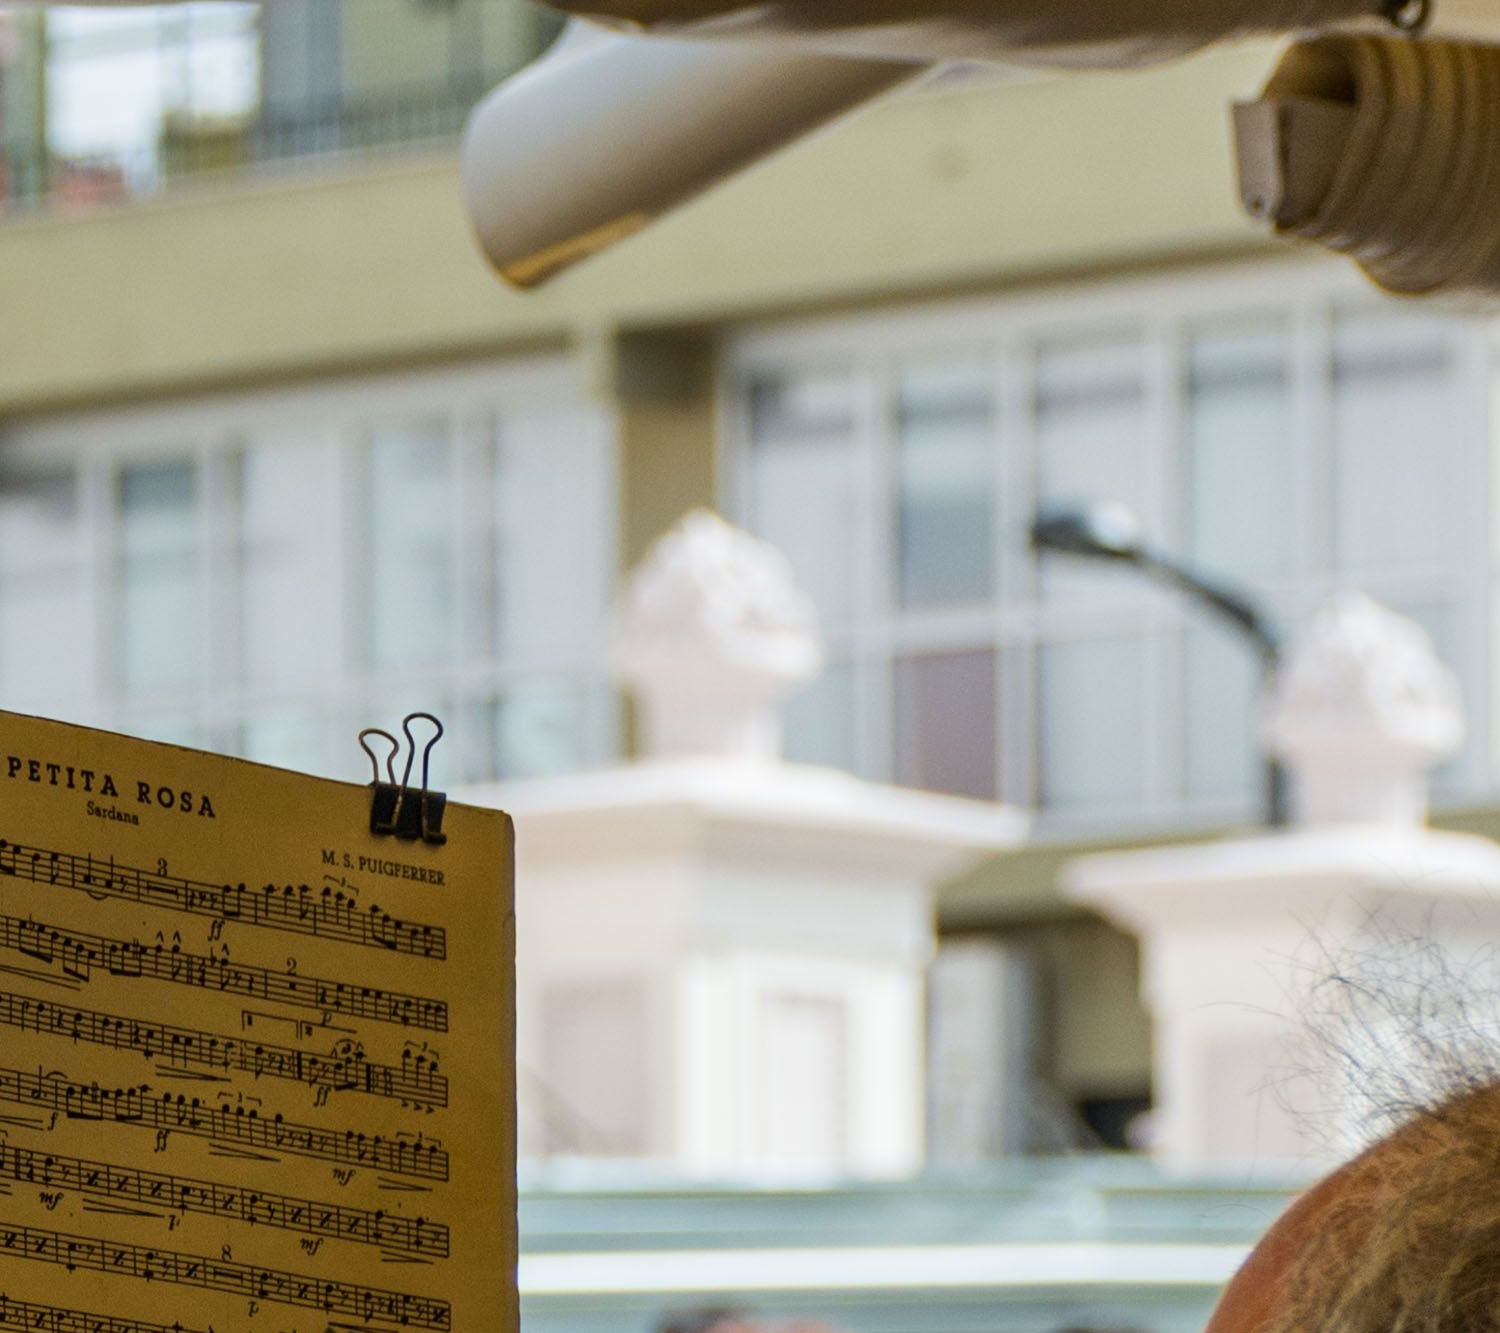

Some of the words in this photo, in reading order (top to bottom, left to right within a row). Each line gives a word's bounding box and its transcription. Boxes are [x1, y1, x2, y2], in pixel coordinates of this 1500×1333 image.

[7, 756, 118, 797] PETITA
[136, 781, 216, 818] ROSA
[86, 800, 139, 825] Sardana
[321, 849, 339, 866] M.
[343, 853, 354, 869] S.
[359, 856, 446, 886] PUIGFERRER
